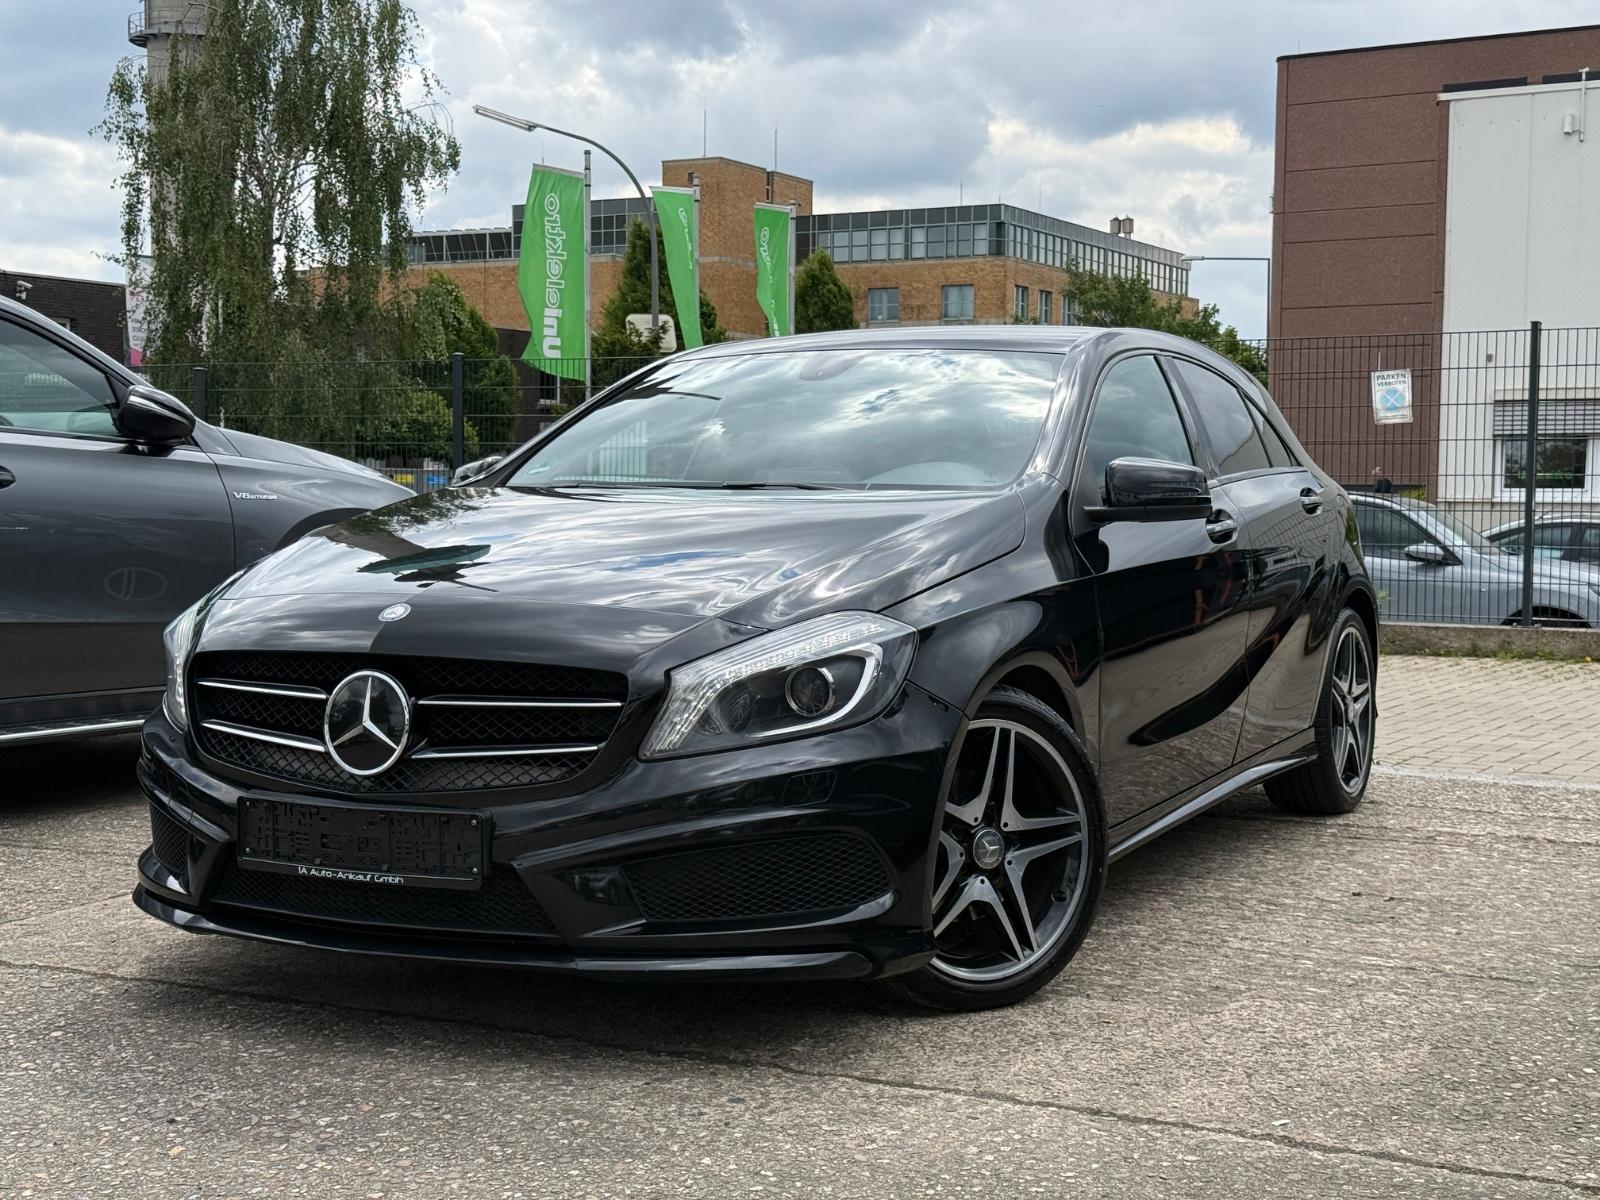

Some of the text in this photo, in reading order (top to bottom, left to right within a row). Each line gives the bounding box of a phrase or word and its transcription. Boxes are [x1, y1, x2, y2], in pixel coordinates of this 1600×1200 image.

[1376, 373, 1407, 381] PARKEN
[298, 866, 308, 875] 1A
[309, 868, 371, 881] Auto-Ankauf
